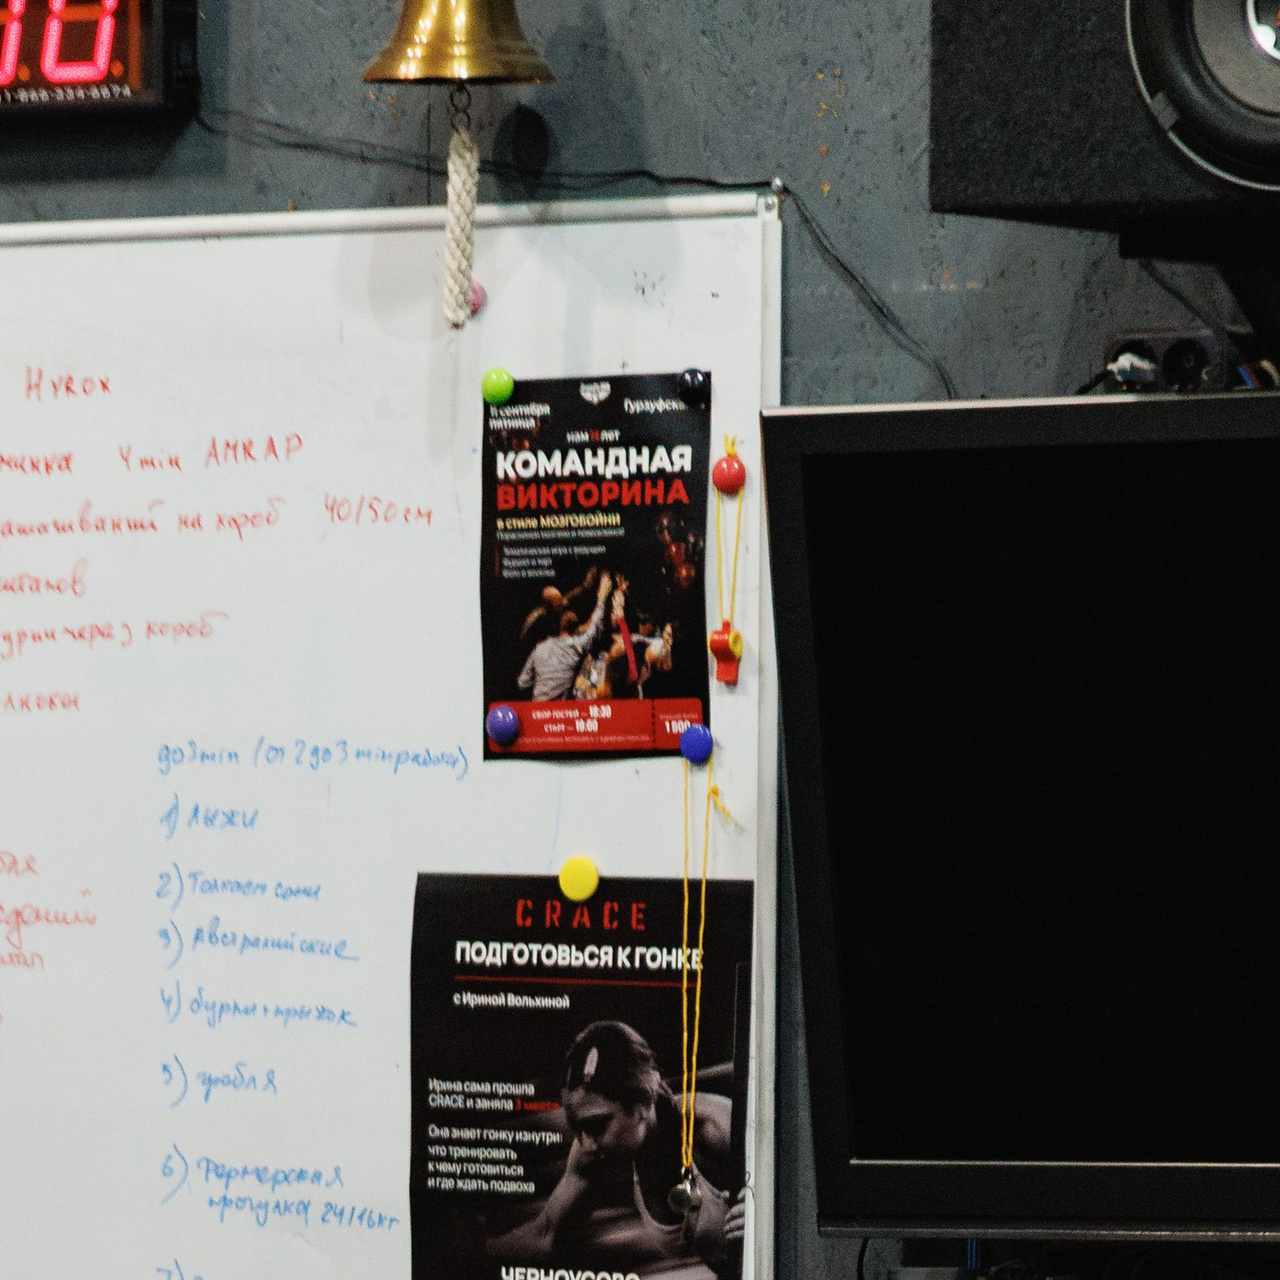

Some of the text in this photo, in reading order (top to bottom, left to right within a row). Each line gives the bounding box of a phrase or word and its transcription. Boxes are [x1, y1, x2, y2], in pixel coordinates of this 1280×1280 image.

[496, 445, 692, 480] КОМАНДНАЯ
[496, 478, 690, 512] ВИКТОРИНА
[515, 898, 647, 931] CRACE
[455, 940, 704, 971] ПОДГОТОВЬСЯ К ГОНКЕ
[462, 990, 505, 1008] Ириной
[428, 1077, 535, 1096] Ирина сама прошла
[428, 1093, 465, 1108] CRACE
[466, 1098, 474, 1109] и
[475, 1098, 514, 1111] заняла
[428, 1123, 450, 1139] Она
[451, 1127, 481, 1140] знает
[483, 1128, 514, 1144] гонку
[428, 1144, 518, 1161] что тренировать
[427, 1161, 524, 1177] к чему готовиться
[427, 1176, 536, 1194] и где ждать подвоха
